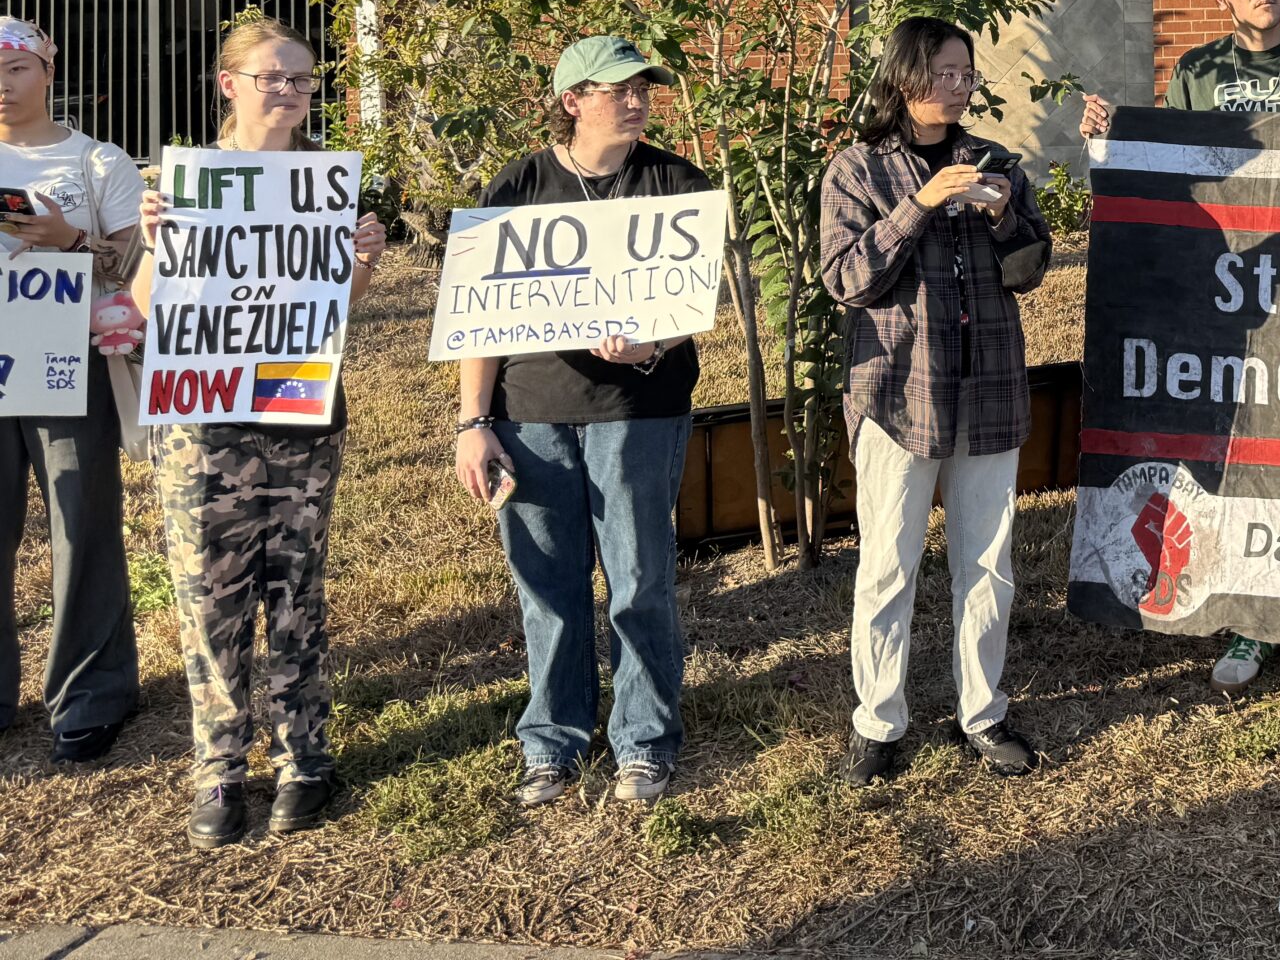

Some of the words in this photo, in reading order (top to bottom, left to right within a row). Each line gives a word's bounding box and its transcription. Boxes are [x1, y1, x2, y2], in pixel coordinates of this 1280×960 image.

[173, 164, 264, 212] LIFT
[290, 165, 356, 214] U.S.
[158, 220, 353, 284] SANCTIONS
[493, 214, 588, 273] NO
[627, 209, 706, 262] U.S.
[230, 285, 276, 302] ON
[450, 259, 719, 314] INTERVENTION!
[154, 300, 343, 356] VENEZUELA
[446, 316, 640, 351] @TAMPABAYSDS
[44, 352, 81, 366] Tampa
[46, 366, 76, 379] Bay
[46, 379, 76, 390] SDS
[148, 366, 244, 415] NOW
[1112, 466, 1170, 494] TAMPA
[1171, 472, 1206, 501] BAY
[1130, 568, 1193, 608] SDS
